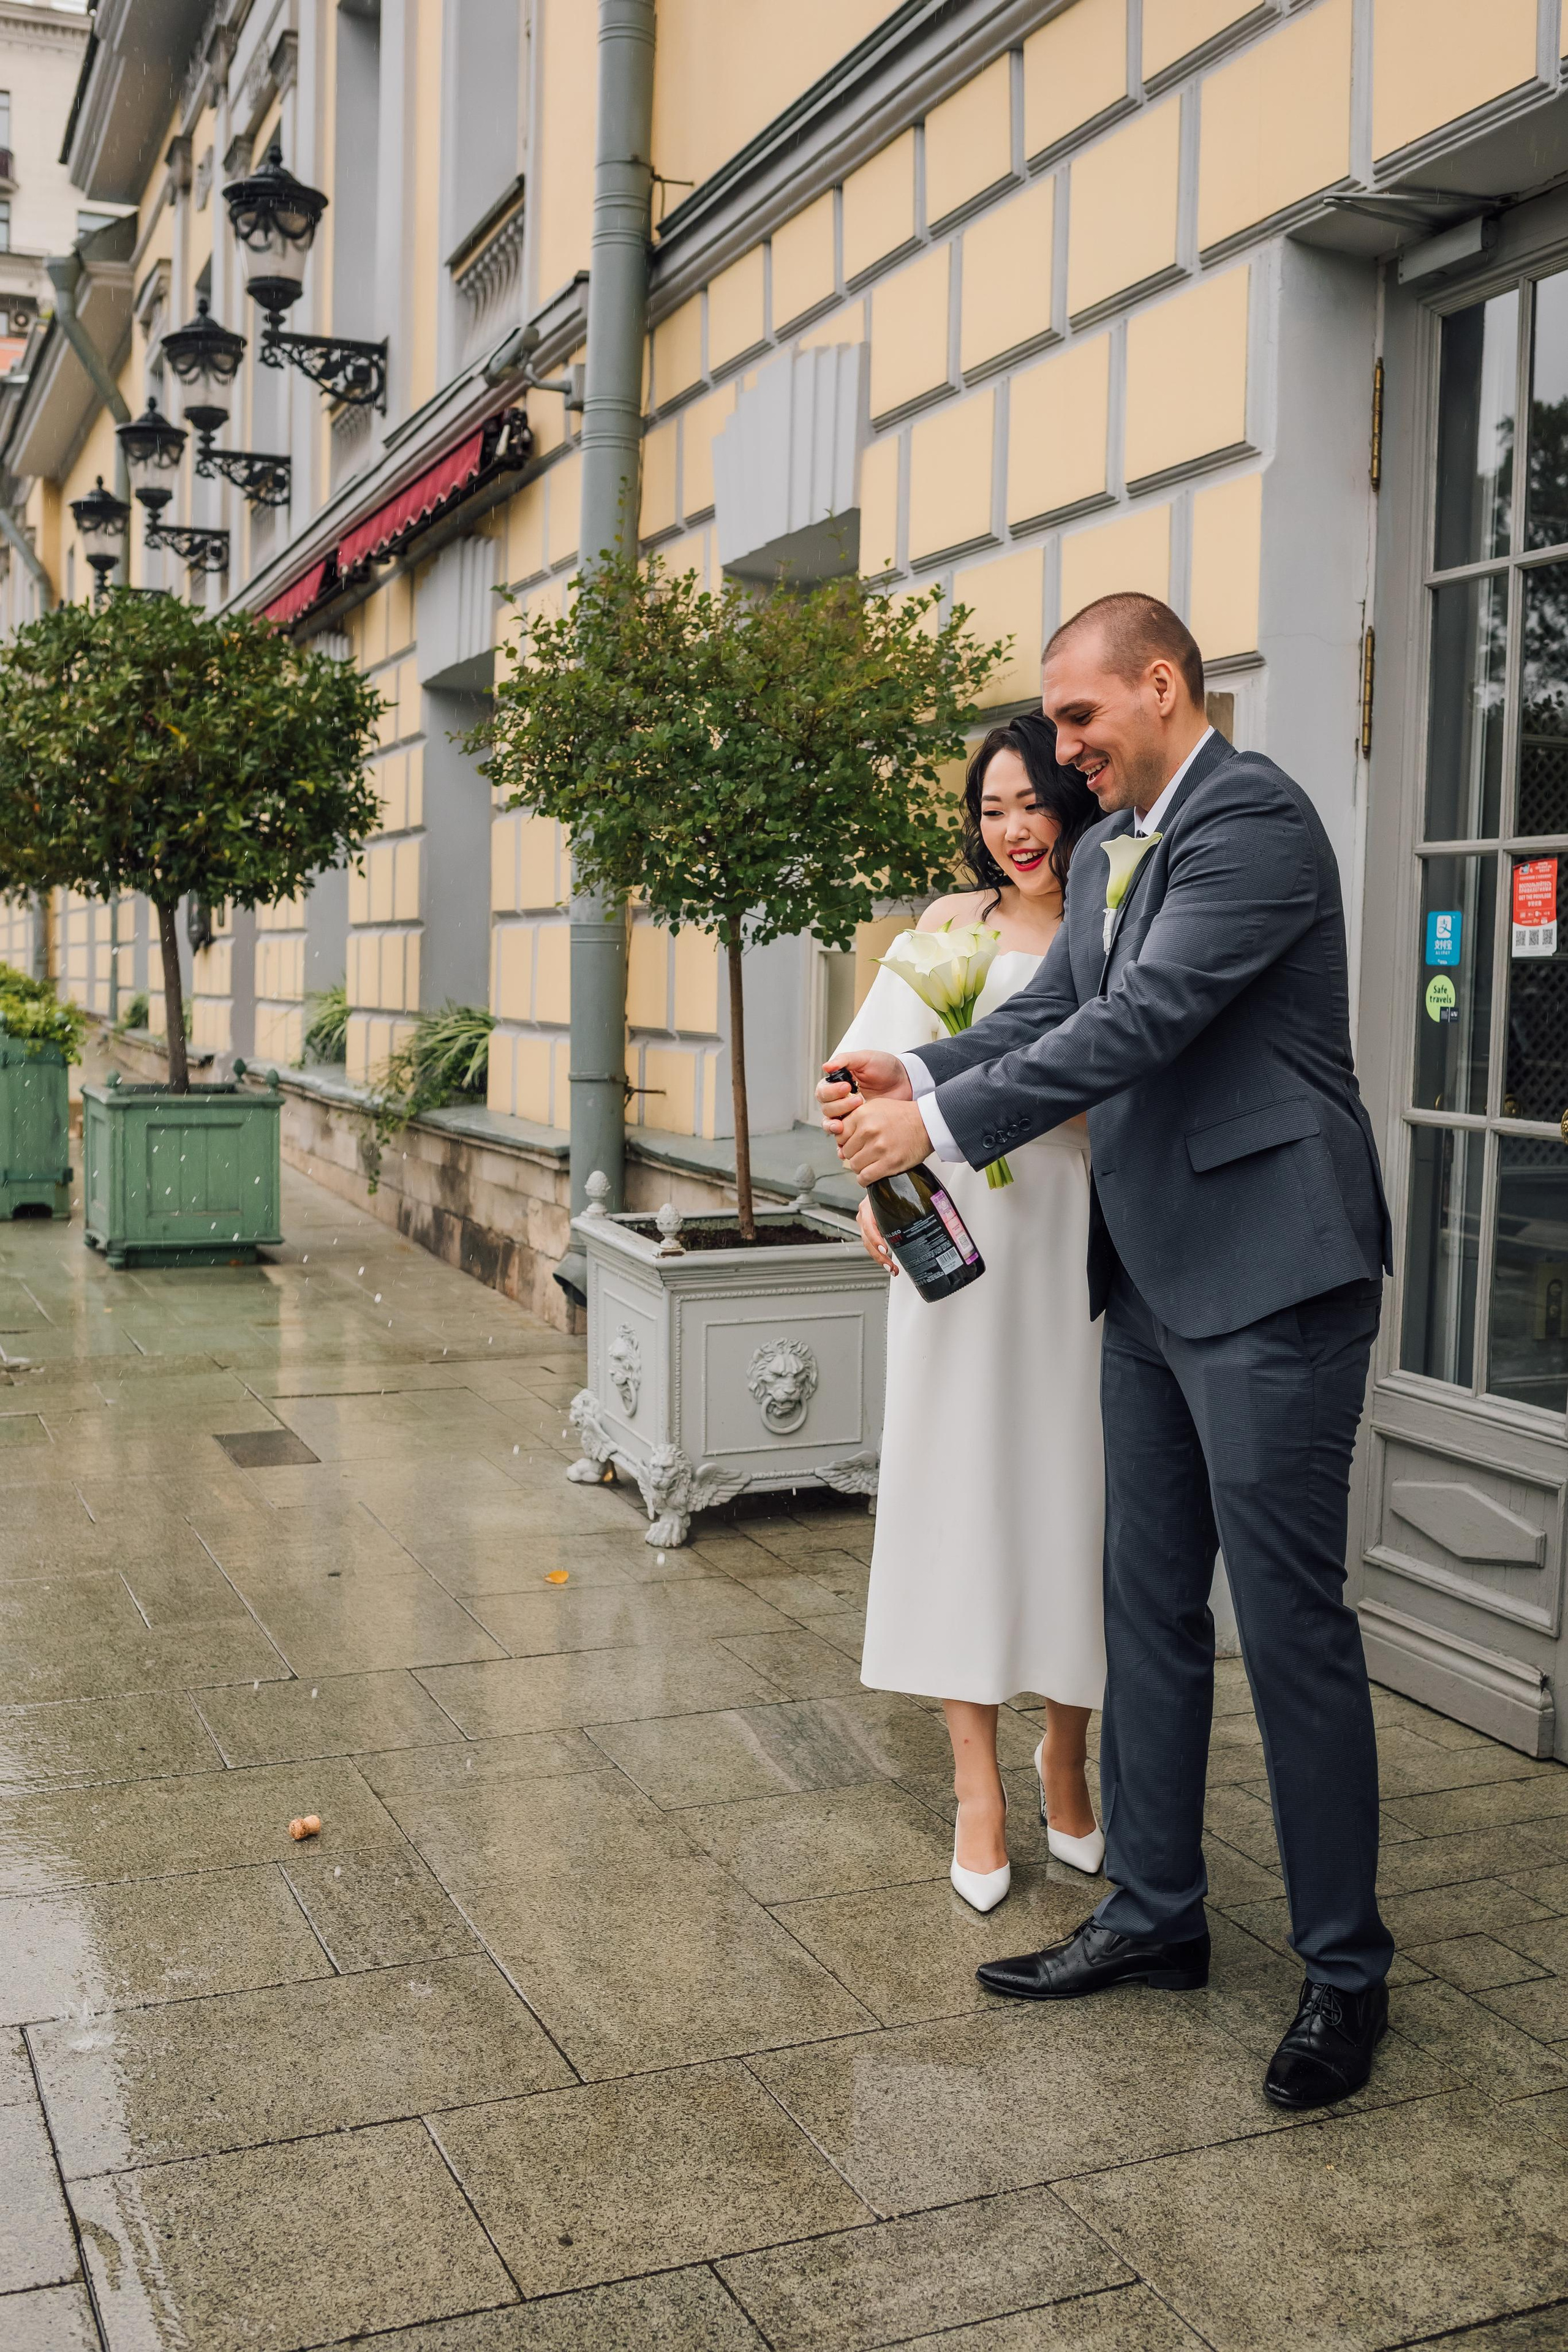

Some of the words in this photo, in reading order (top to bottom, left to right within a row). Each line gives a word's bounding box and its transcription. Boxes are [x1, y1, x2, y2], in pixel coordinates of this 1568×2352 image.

[1434, 940, 1452, 950] 支付宝
[1433, 984, 1447, 993] Safe
[1430, 994, 1452, 1003] travels
